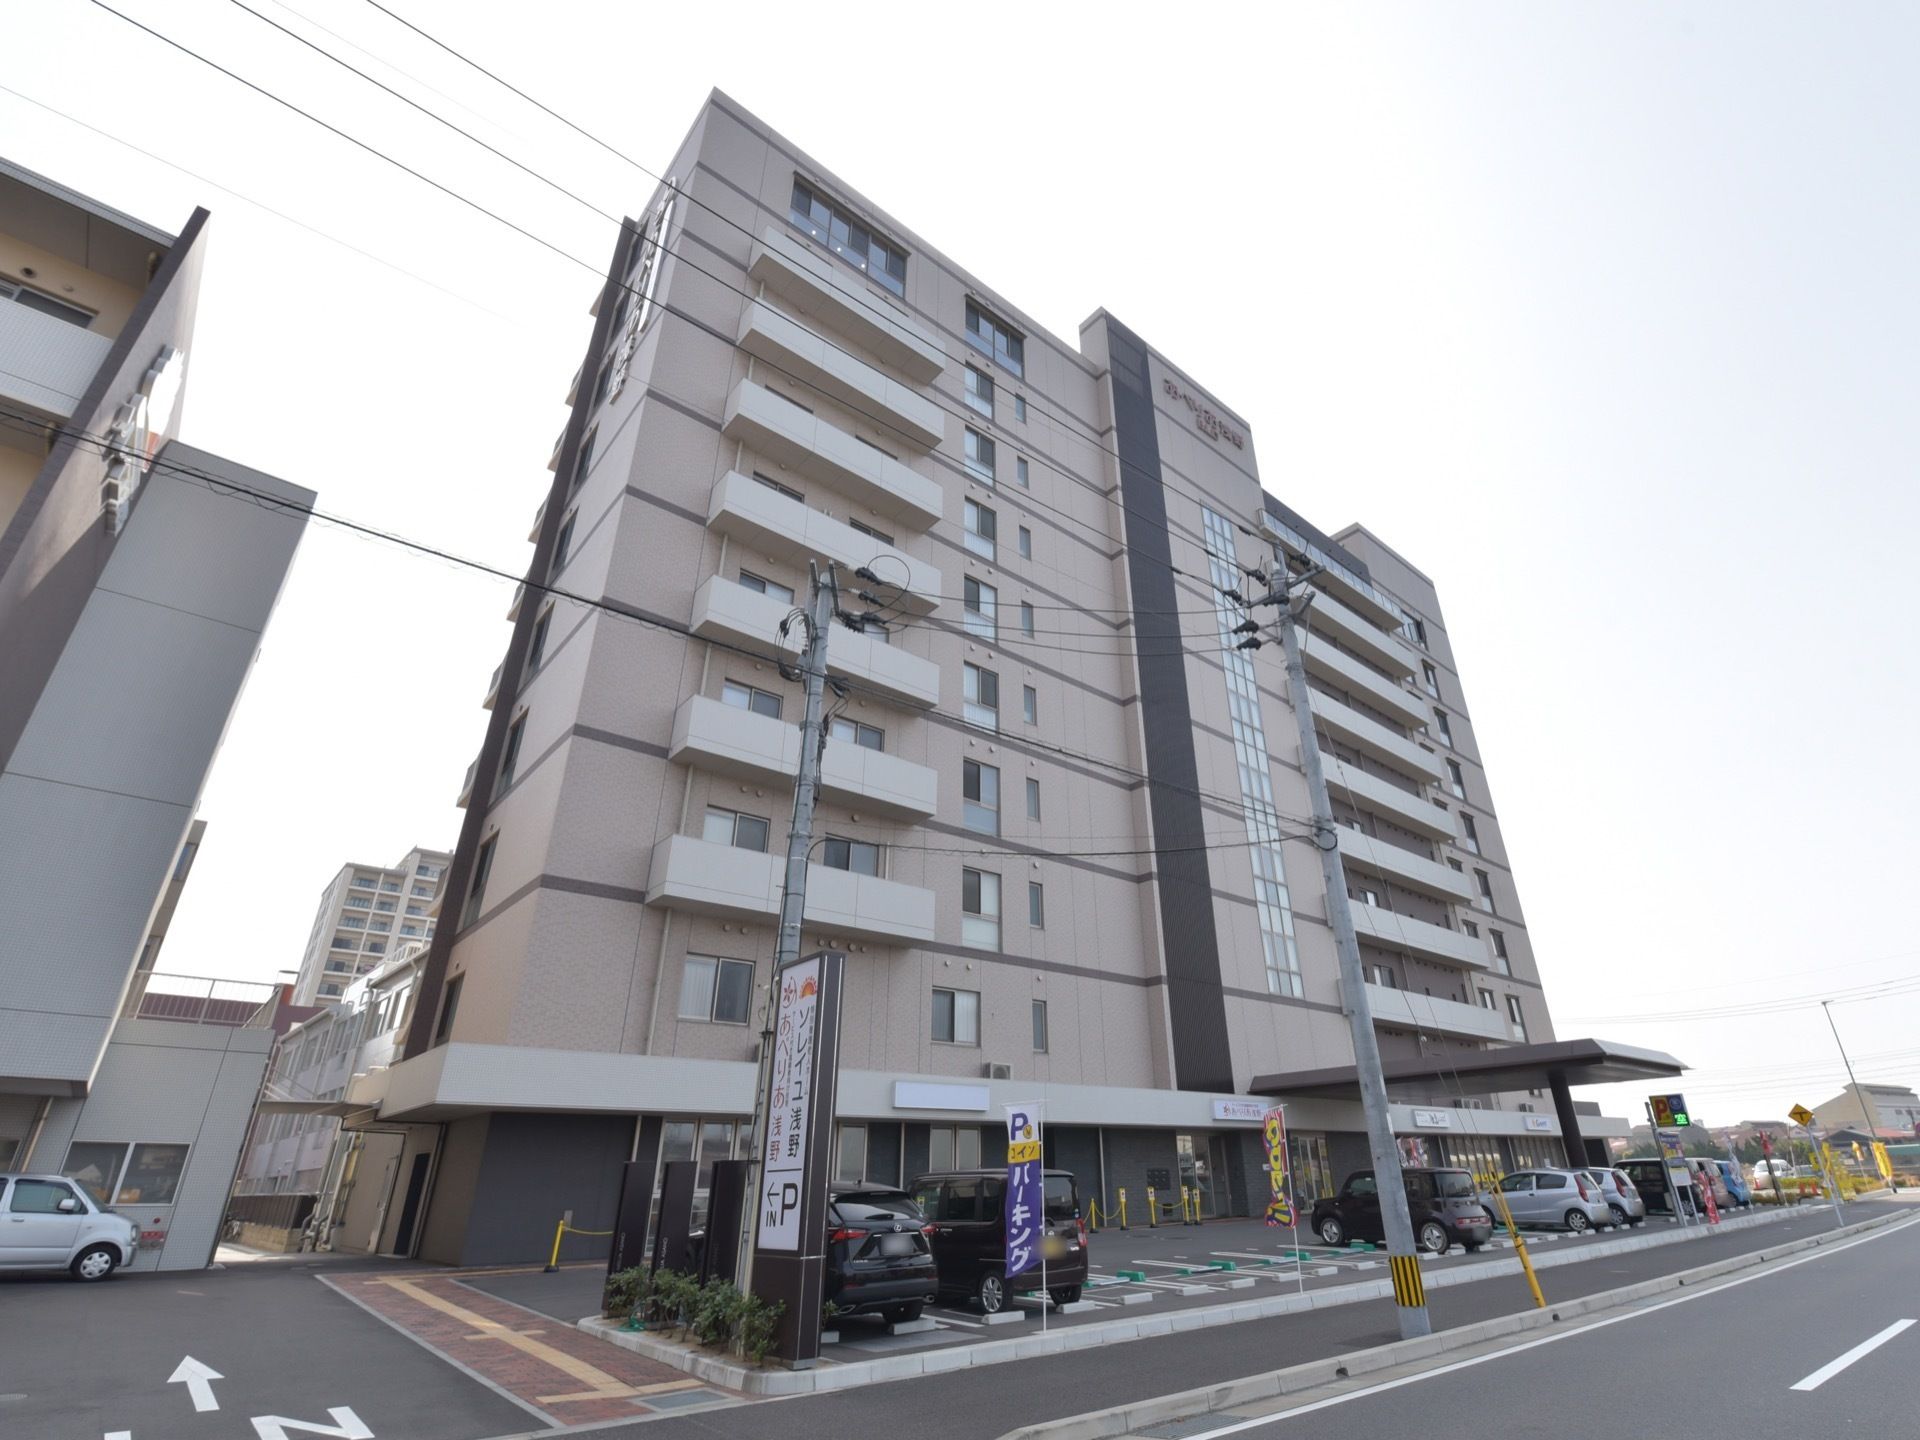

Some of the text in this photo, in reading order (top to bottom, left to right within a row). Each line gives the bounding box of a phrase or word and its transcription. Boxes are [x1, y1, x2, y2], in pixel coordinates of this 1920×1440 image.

[788, 1007, 810, 1158] ソレイユ浅野
[1655, 1099, 1668, 1121] P
[1011, 1112, 1029, 1141] P
[1011, 1145, 1036, 1160] コイン
[781, 1183, 797, 1226] P
[1010, 1163, 1032, 1273] パーキング
[765, 1211, 776, 1228] IN
